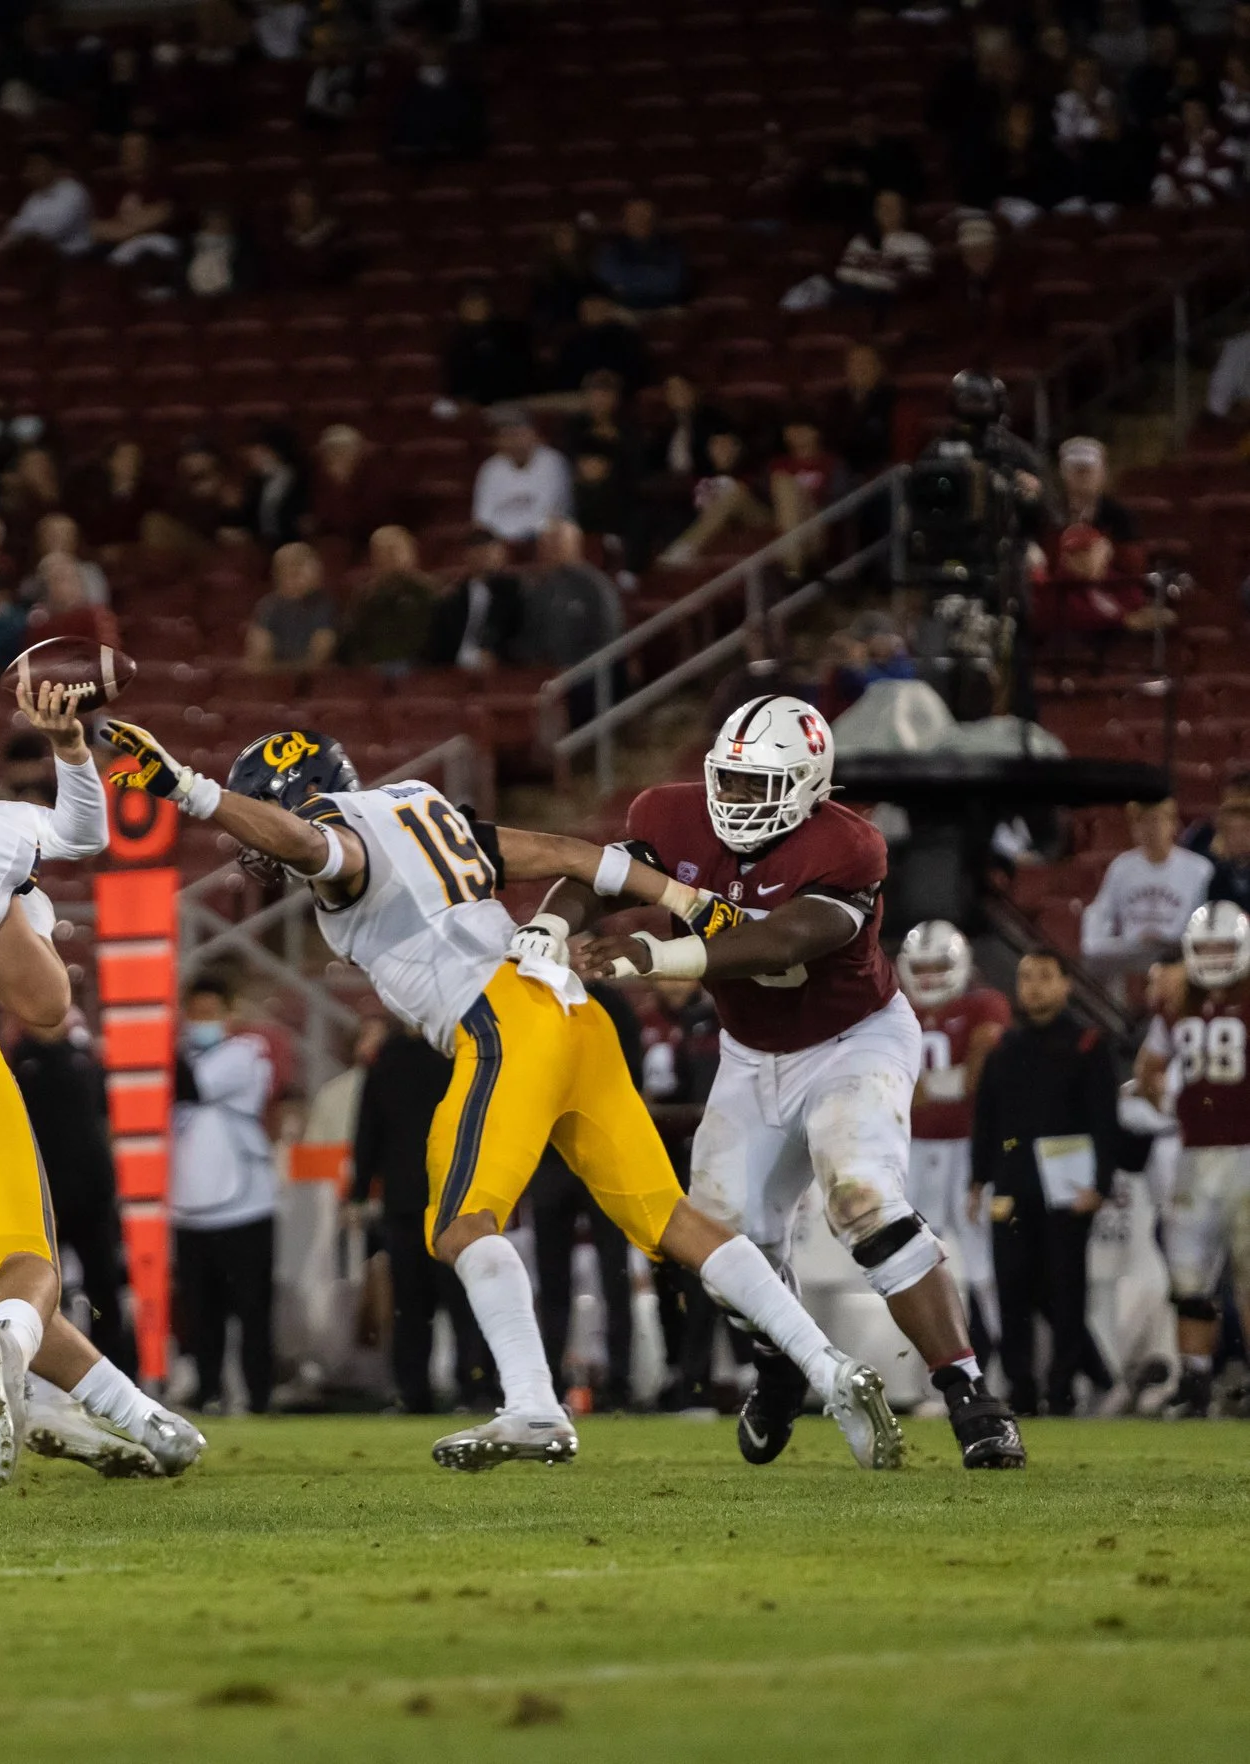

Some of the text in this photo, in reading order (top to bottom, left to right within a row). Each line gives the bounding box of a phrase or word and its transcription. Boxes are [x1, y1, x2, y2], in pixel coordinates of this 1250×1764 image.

[263, 731, 320, 773] Cal
[391, 796, 496, 908] 19
[1170, 1016, 1246, 1085] 88
